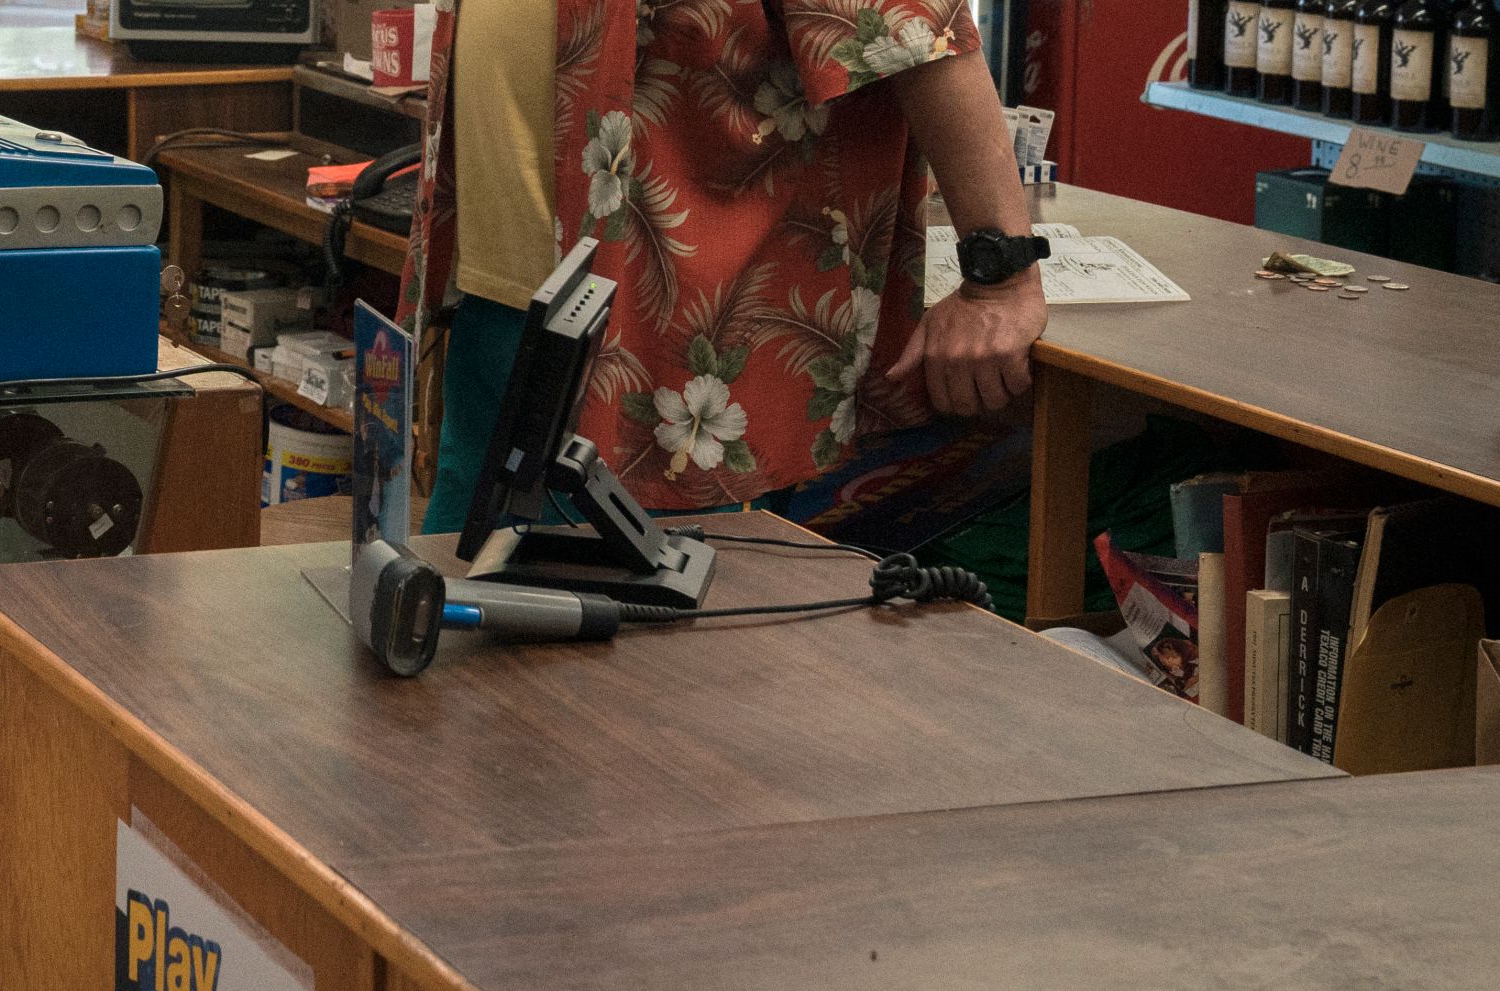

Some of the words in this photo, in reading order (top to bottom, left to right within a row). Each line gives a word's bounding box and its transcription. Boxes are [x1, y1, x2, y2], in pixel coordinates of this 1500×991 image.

[1360, 134, 1402, 155] WINE
[1301, 575, 1309, 592] A
[1318, 629, 1331, 666] TEXACO
[1297, 609, 1308, 728] DERRICK
[1324, 635, 1340, 704] INFORMATION
[1315, 669, 1328, 706] CREDIT
[1313, 707, 1325, 736] CARD
[1324, 703, 1335, 719] ON
[1322, 719, 1334, 743] THE
[127, 888, 222, 991] Play
